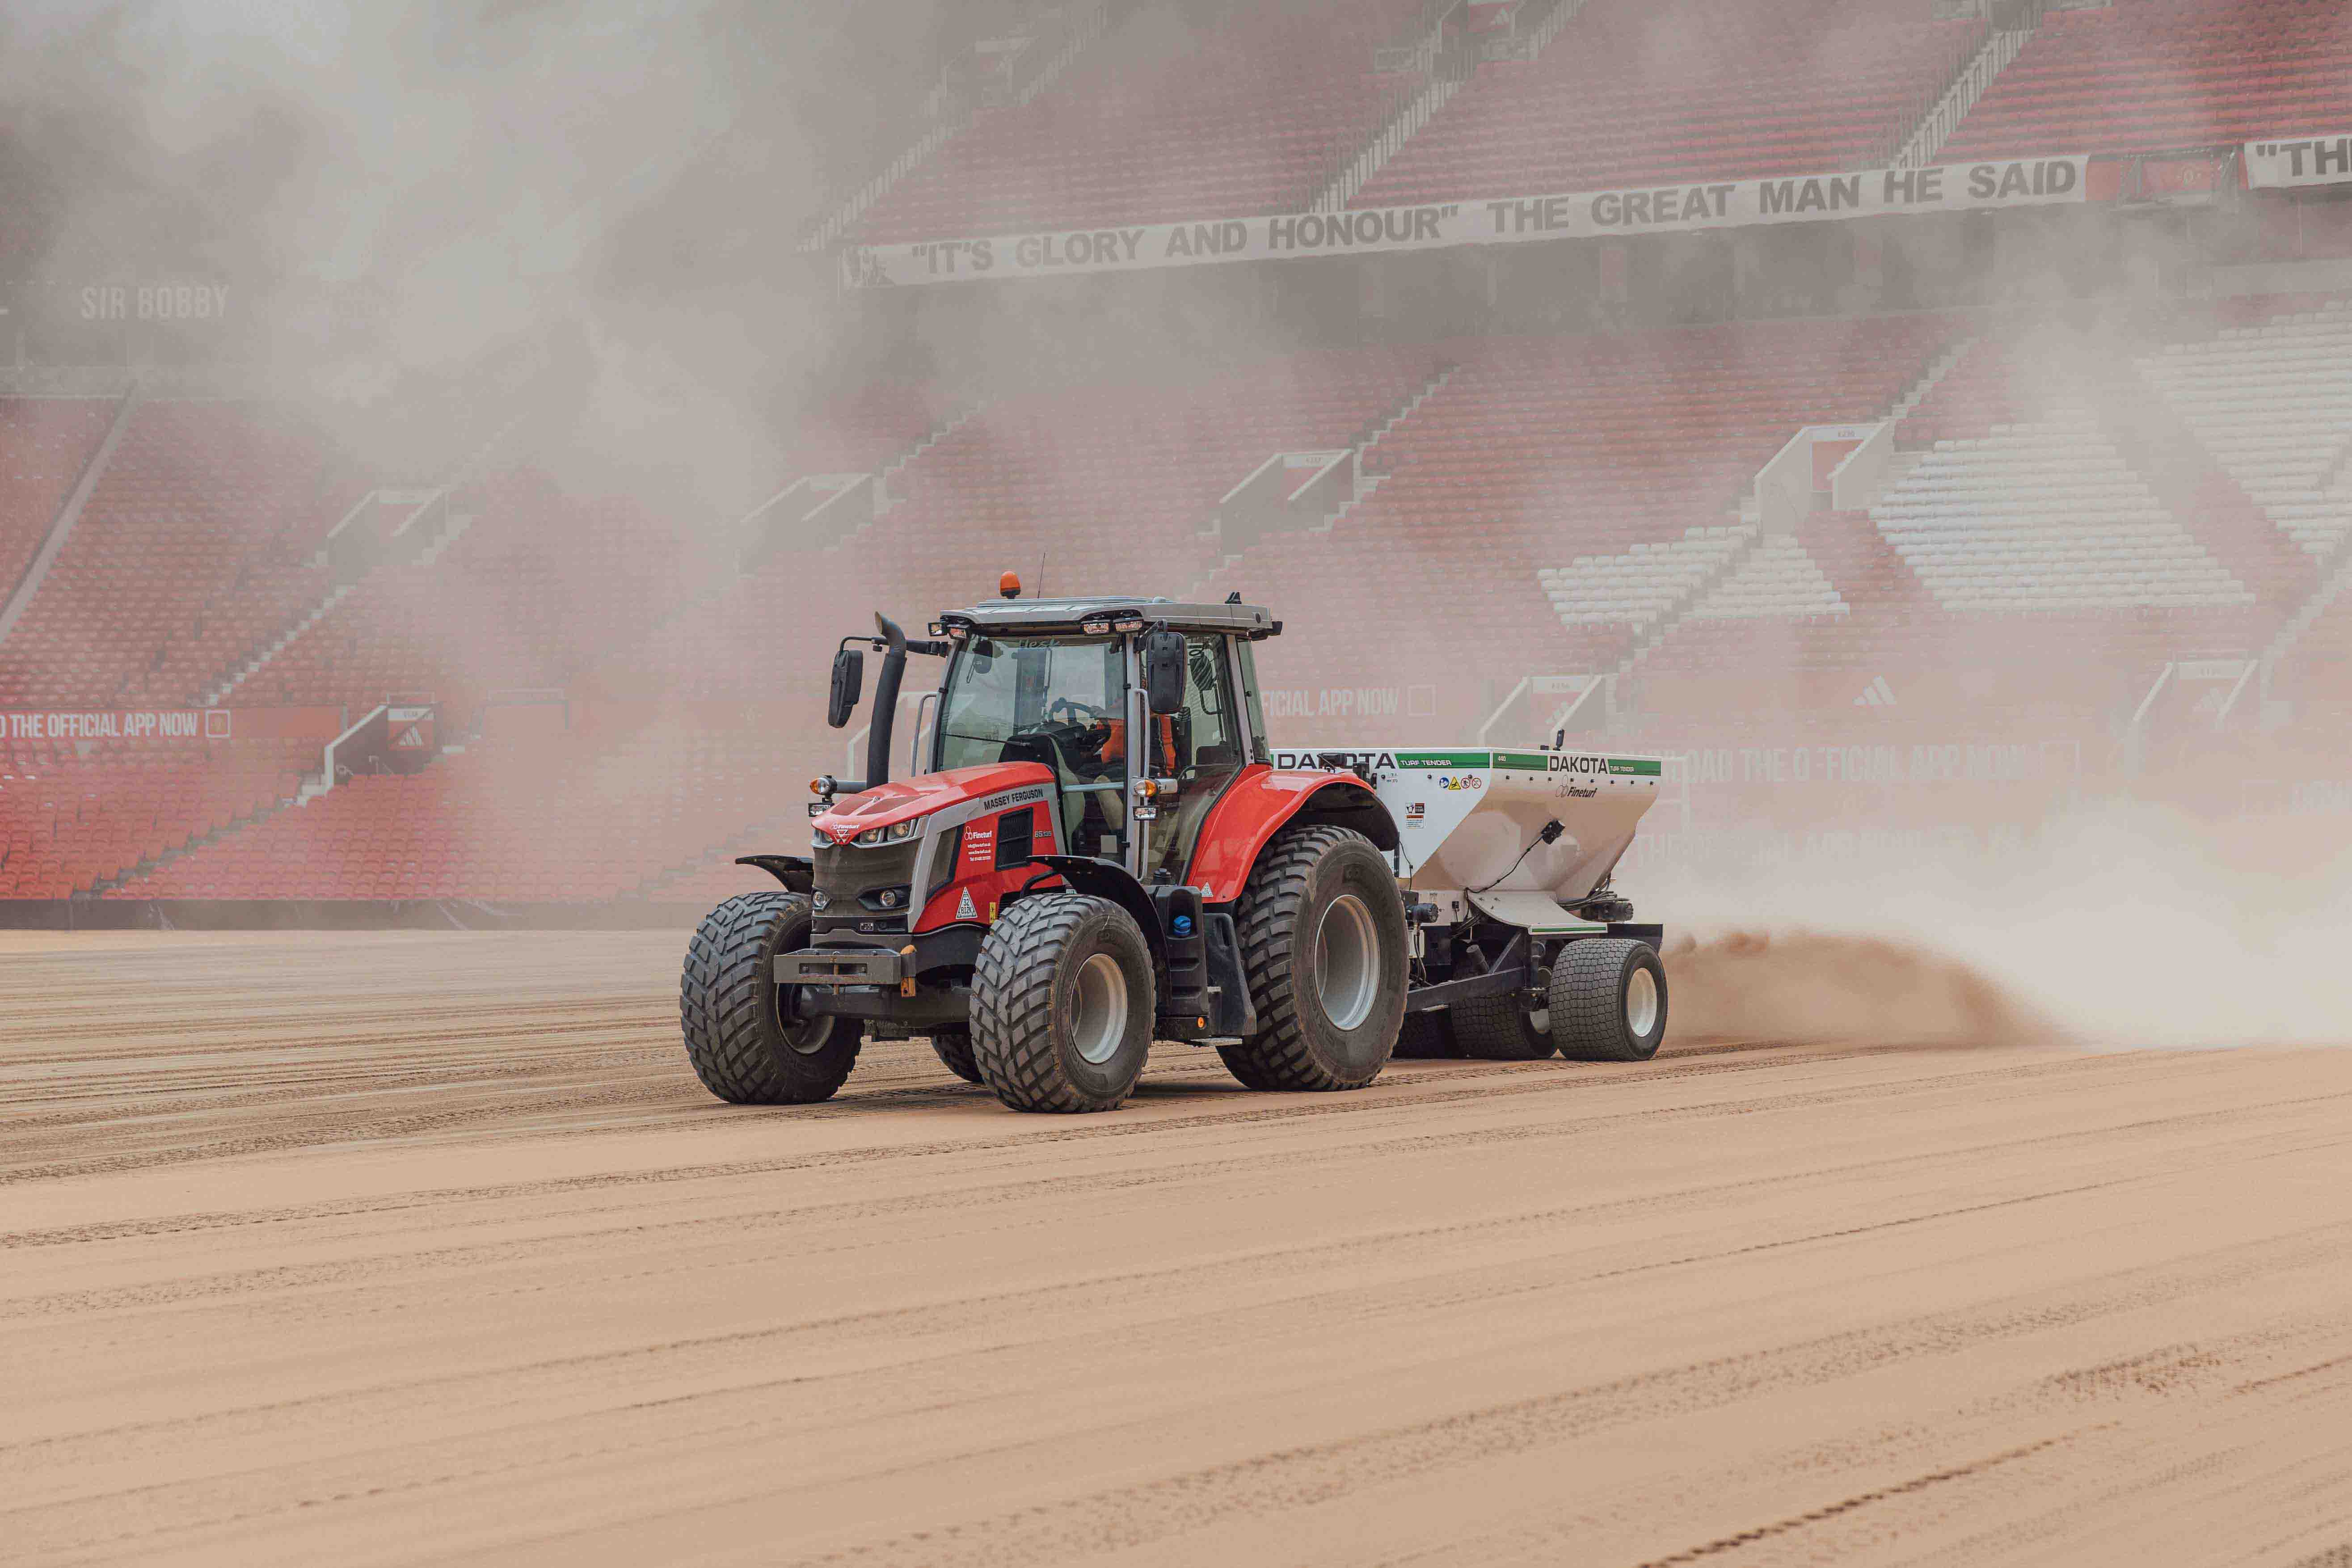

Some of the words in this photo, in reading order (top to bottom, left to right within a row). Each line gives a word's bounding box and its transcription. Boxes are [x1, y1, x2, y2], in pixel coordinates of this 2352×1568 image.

[2256, 138, 2352, 177] "TH
[912, 240, 994, 274] "IT'S
[1016, 228, 1145, 268] GLORY
[1165, 221, 1247, 257] AND
[1269, 204, 1458, 250] HONOUR"
[1487, 196, 1569, 233] THE
[1591, 185, 1735, 226] GREAT
[1759, 175, 1860, 213] MAN
[1884, 168, 1944, 203] HE
[1968, 160, 2076, 200] SAID
[80, 286, 125, 320] SIR
[137, 284, 229, 319] BOBBY
[1319, 690, 1352, 716] APP
[1356, 688, 1398, 716] NOW
[9, 714, 44, 738] THE
[47, 713, 121, 738] OFFICIAL
[123, 712, 156, 737] APP
[159, 712, 197, 737] NOW
[1278, 753, 1395, 769] DAOTA
[1550, 756, 1608, 774] DAKOTA
[983, 796, 1010, 810] MASSEY
[1012, 788, 1044, 802] FERGUSON
[1567, 787, 1598, 797] Fineturf
[973, 830, 992, 839] Fineturf
